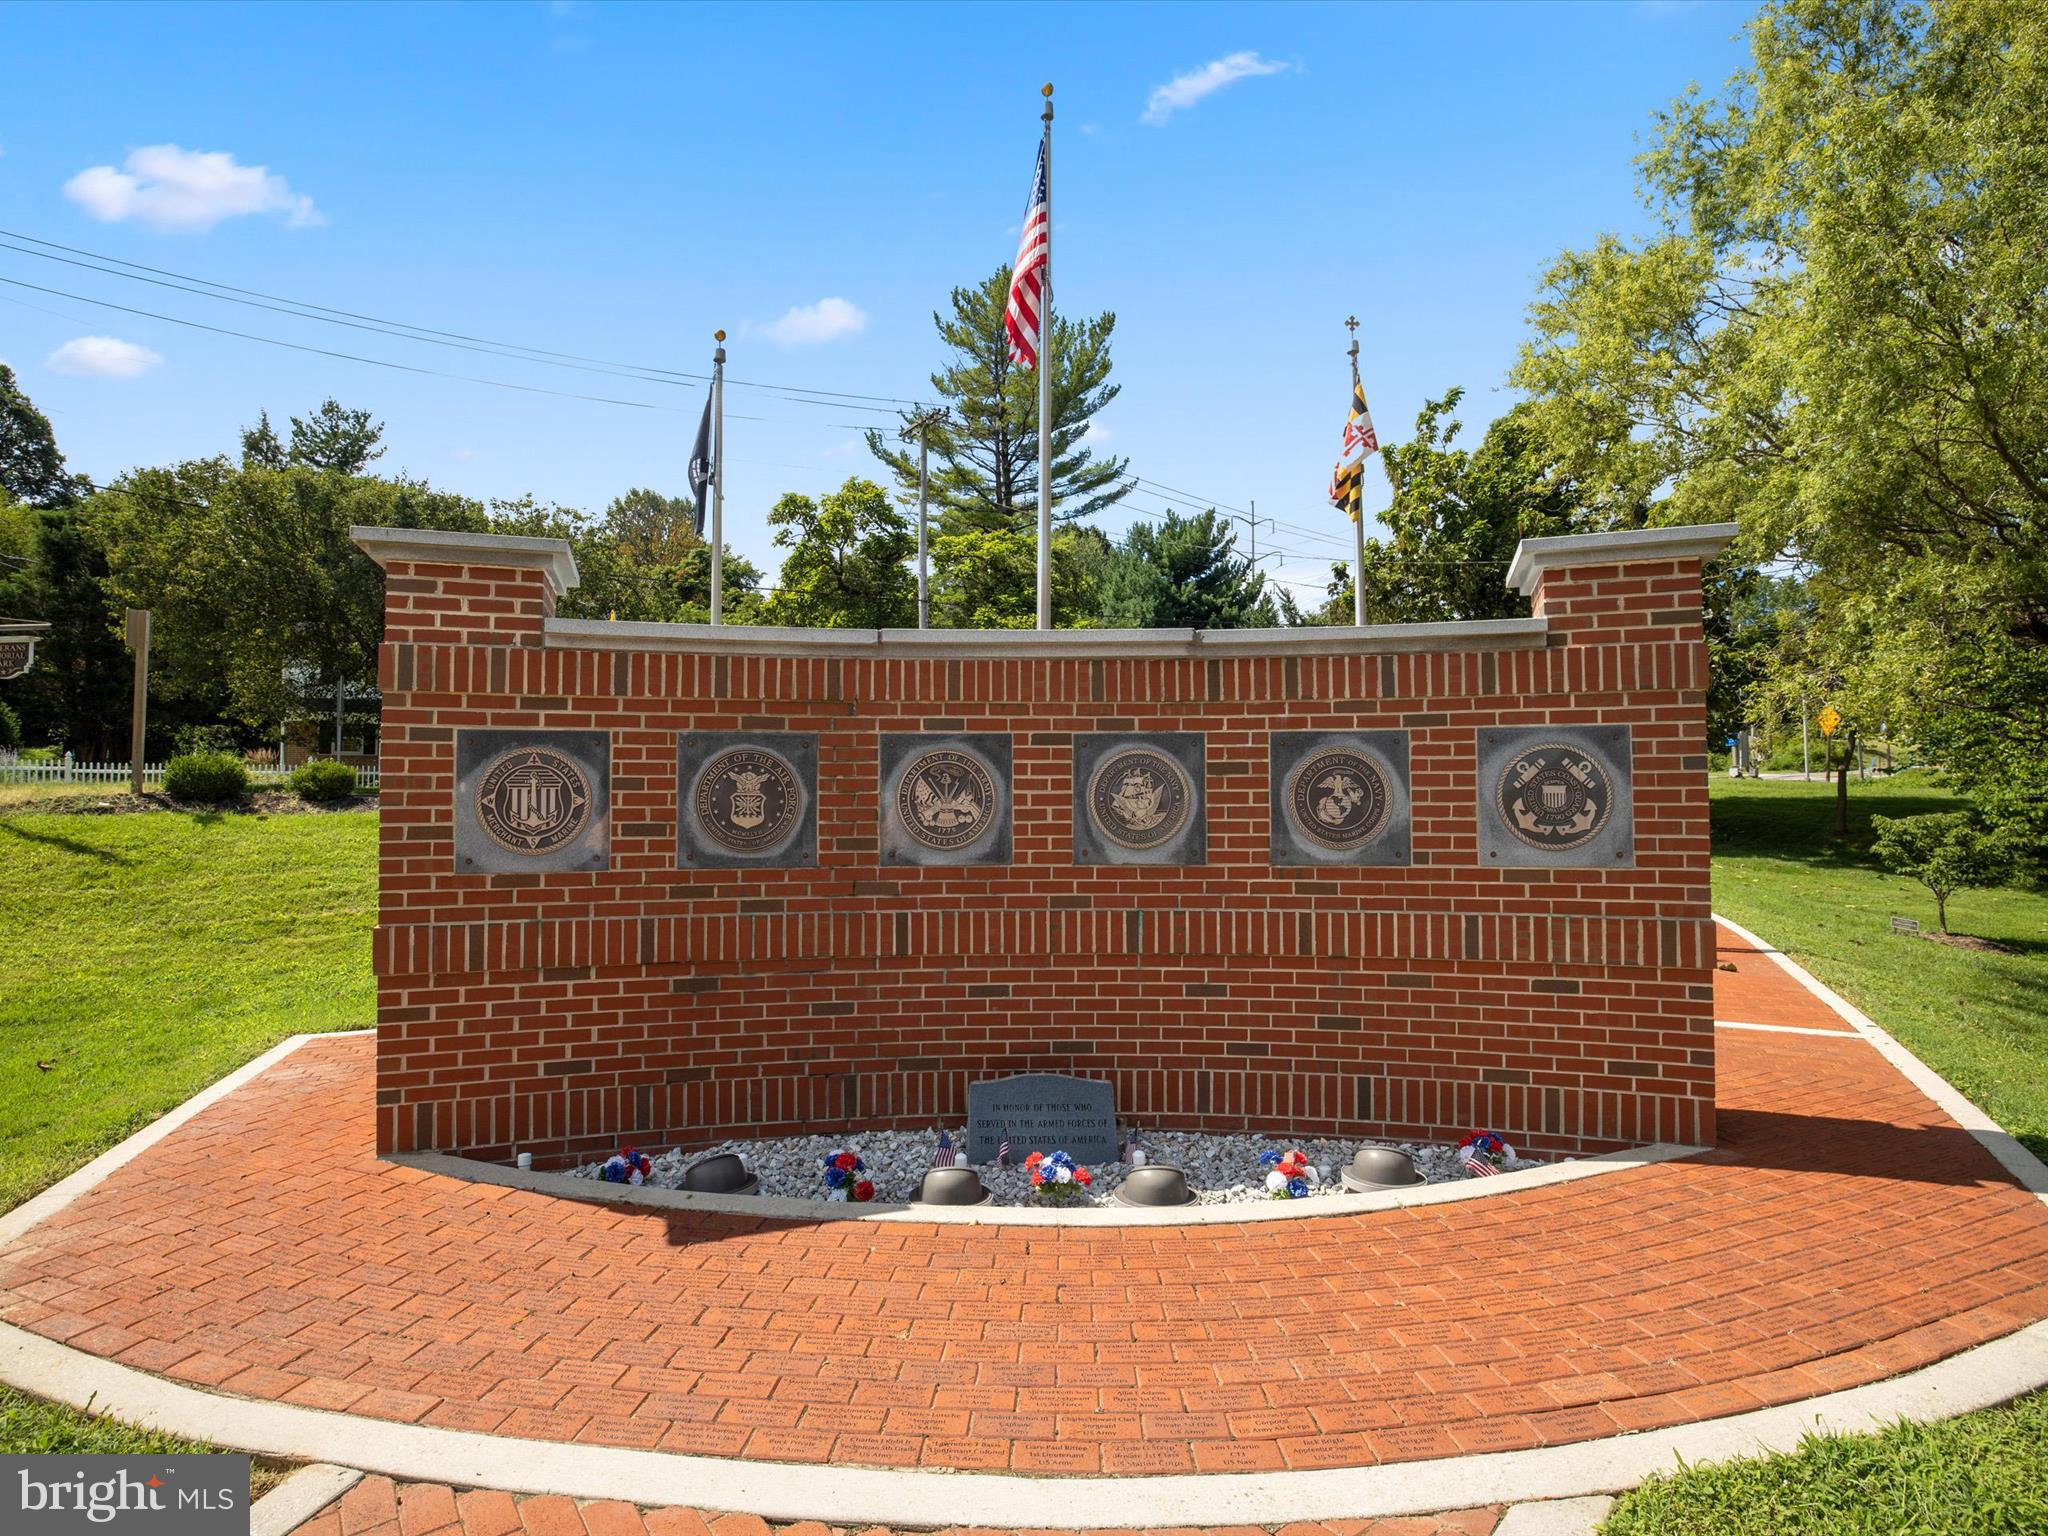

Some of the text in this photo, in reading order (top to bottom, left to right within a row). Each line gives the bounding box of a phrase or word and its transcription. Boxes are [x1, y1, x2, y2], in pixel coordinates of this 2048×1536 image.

[487, 760, 580, 789] UNITED STATES
[699, 754, 799, 821] DEPARTMENT OF THE AIR FORCE
[902, 754, 944, 795] DEPARTMENT
[963, 757, 978, 771] THE
[978, 772, 992, 796] ARMY
[1100, 758, 1138, 793] DEPARTMENT
[1152, 760, 1167, 773] THE
[1166, 771, 1180, 791] NAVY
[1297, 757, 1346, 801] DEPARTMENT
[1369, 775, 1383, 802] NAVY
[1528, 770, 1557, 788] STATES
[1559, 771, 1580, 790] COAST
[487, 814, 578, 846] MERCHANT MARINE
[900, 802, 993, 846] UNITED STATES OF AMERICA
[1100, 803, 1117, 831] UNITED
[1118, 828, 1146, 840] STATES
[977, 1120, 1107, 1128] SERVED IN THE ARMED FORCES OF
[980, 1136, 1106, 1144] THE UITED STATES OF AMERICA
